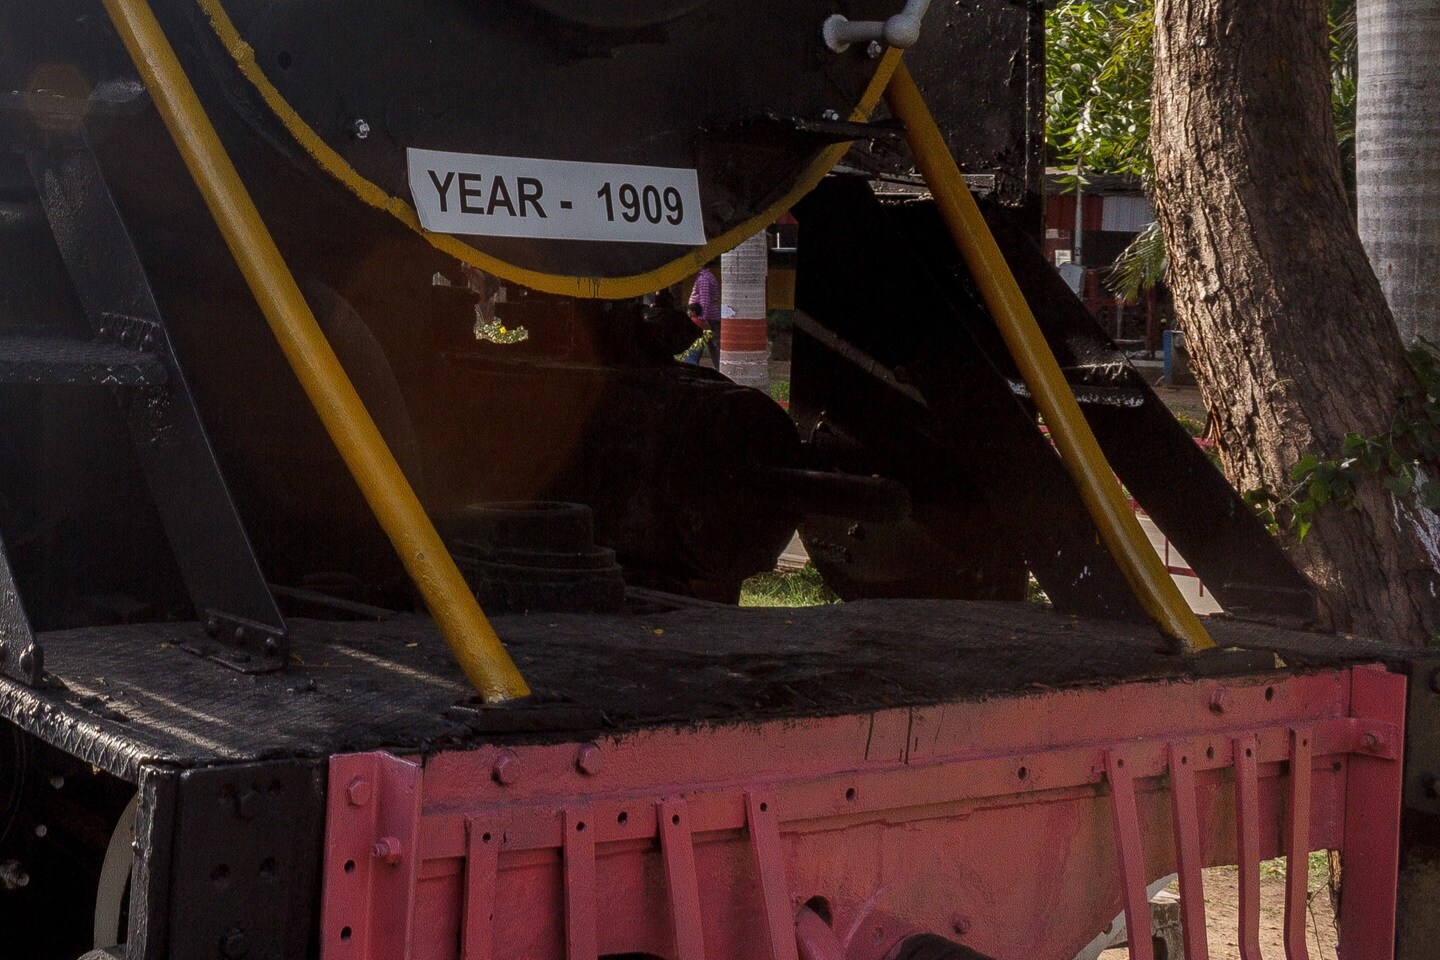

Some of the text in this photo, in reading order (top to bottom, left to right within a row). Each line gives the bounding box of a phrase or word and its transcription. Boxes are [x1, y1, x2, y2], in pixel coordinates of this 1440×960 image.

[427, 169, 684, 225] YEAR - 1909
